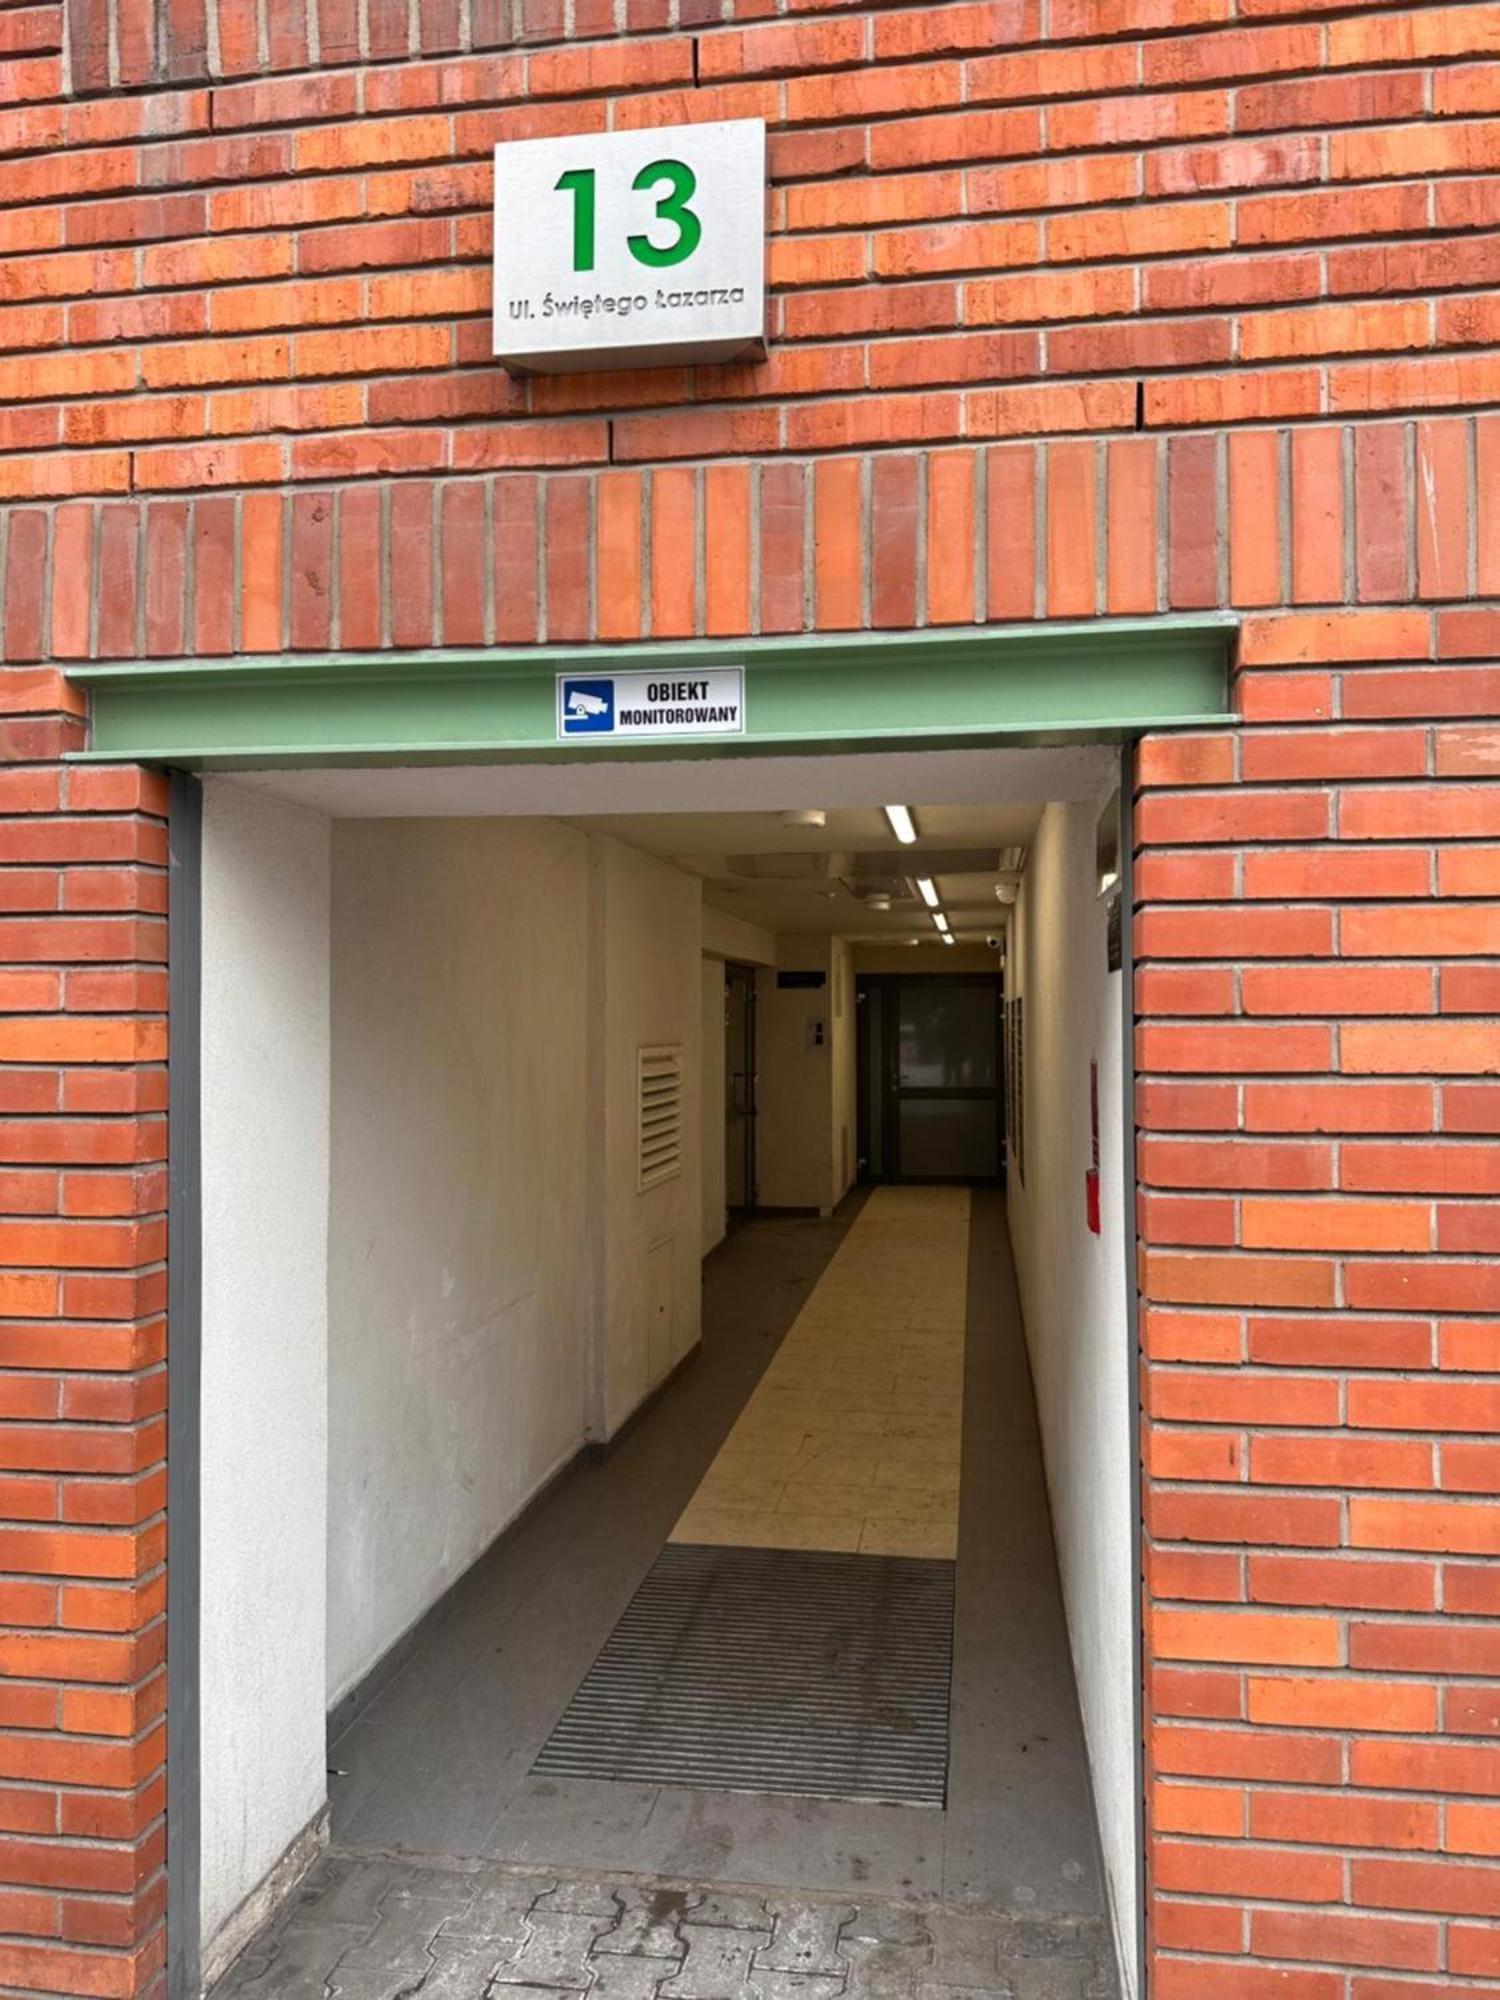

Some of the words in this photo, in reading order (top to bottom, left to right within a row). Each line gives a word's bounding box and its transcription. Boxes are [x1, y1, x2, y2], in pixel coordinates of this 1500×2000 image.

[554, 159, 702, 272] 13
[542, 291, 648, 320] Świętego
[654, 285, 744, 309] Łazarza
[647, 681, 709, 702] OBIEKT
[619, 706, 738, 726] MONITOROWANY
